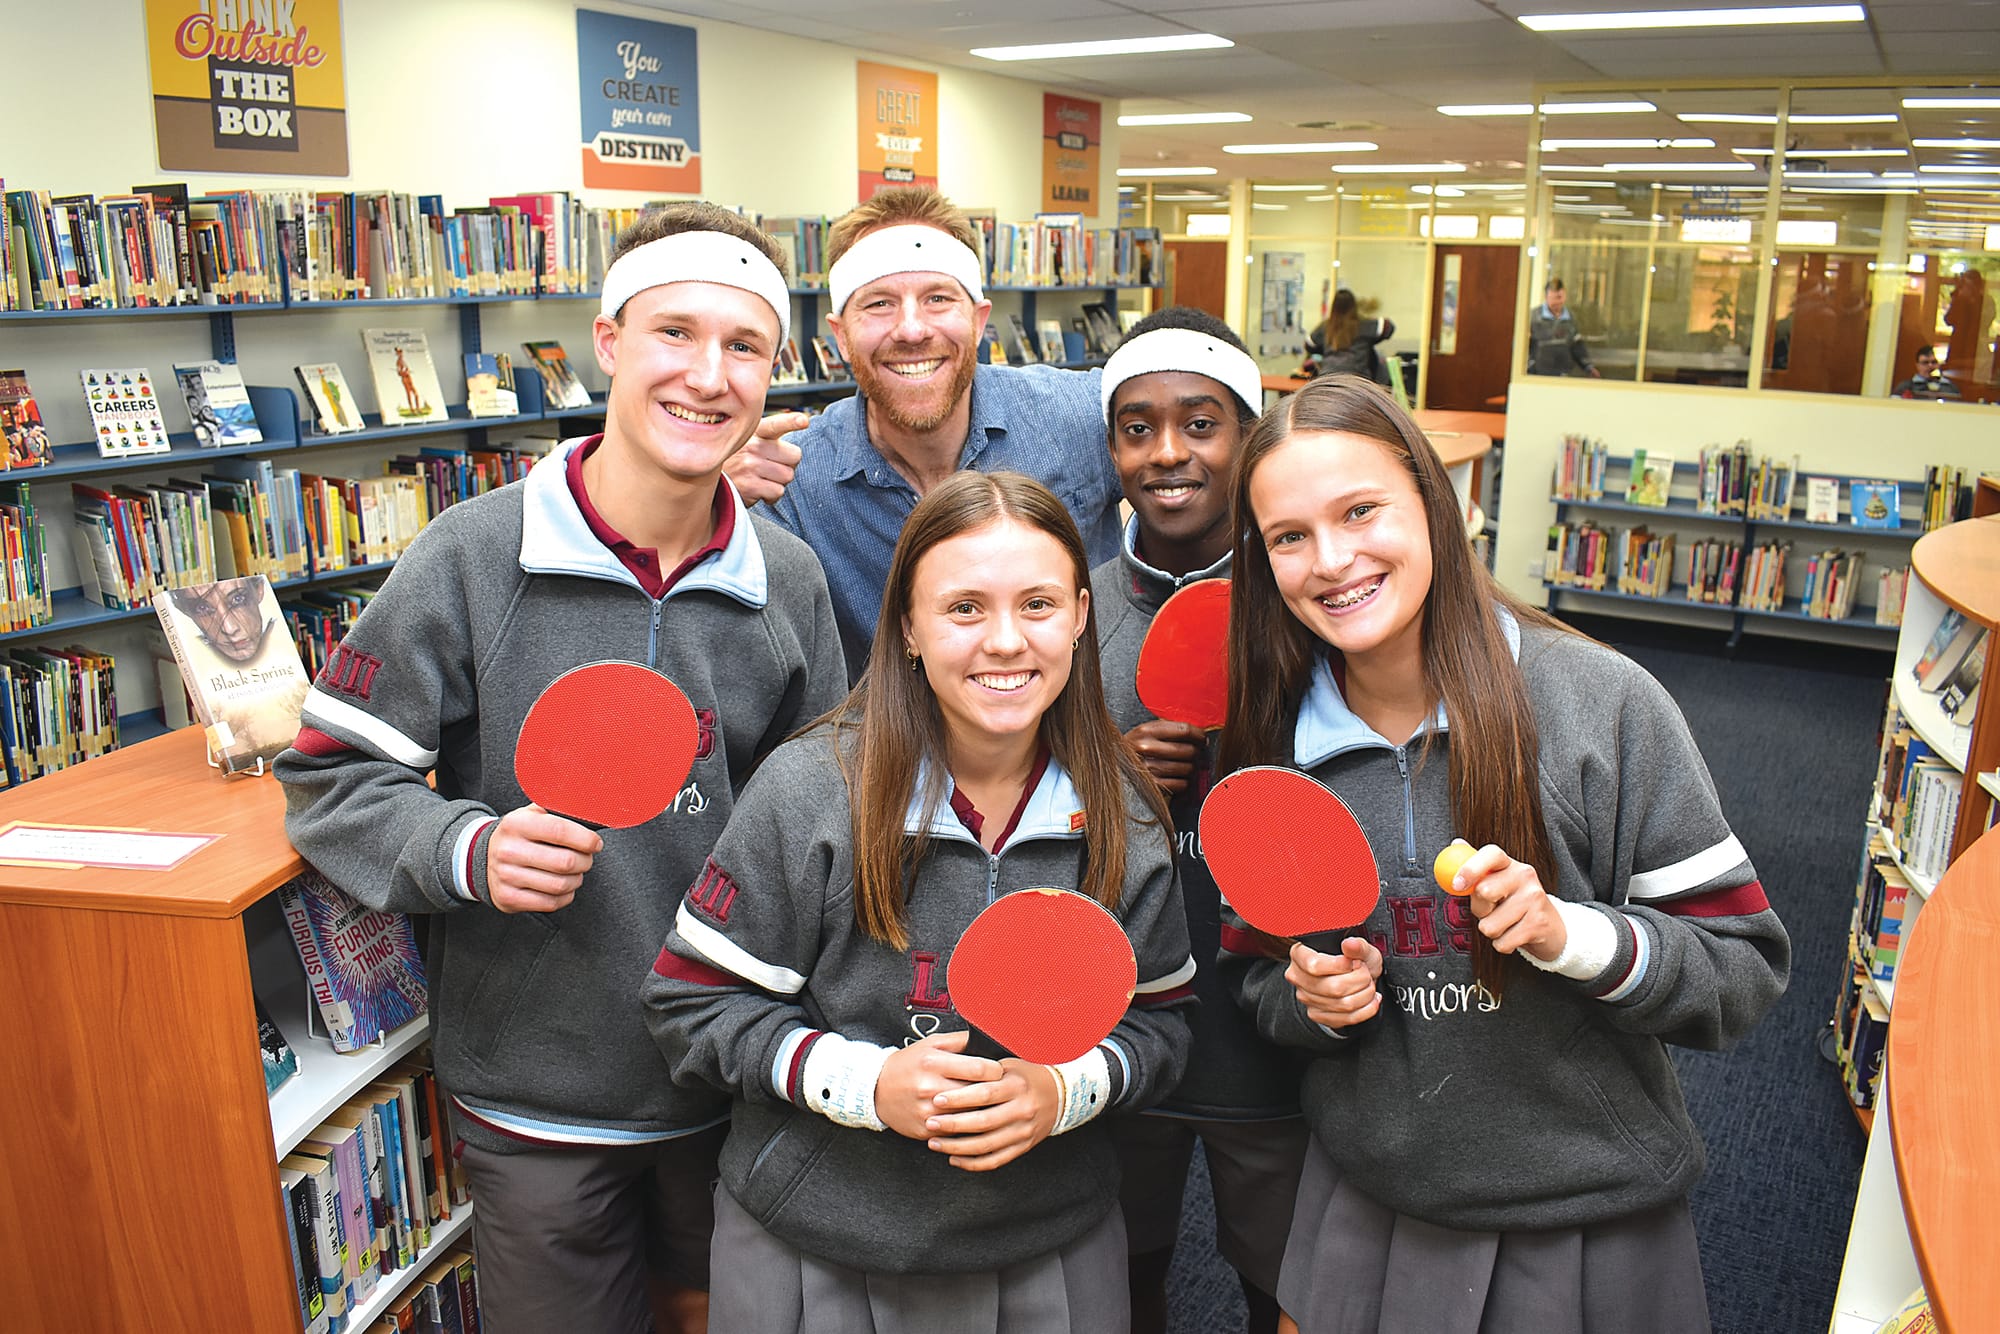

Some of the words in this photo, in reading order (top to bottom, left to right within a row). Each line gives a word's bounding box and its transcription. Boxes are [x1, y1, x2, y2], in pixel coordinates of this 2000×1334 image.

[199, 0, 297, 38] HINK
[175, 14, 326, 67] Outside
[617, 40, 661, 80] You
[214, 69, 291, 103] THE
[602, 79, 681, 107] CREATE
[217, 105, 293, 138] BOX
[611, 107, 644, 128] your
[646, 111, 672, 127] own
[877, 88, 920, 128] GREAT
[600, 137, 685, 162] DESTINY
[93, 399, 156, 414] CAREERS
[95, 410, 158, 422] HANDBOOK
[160, 607, 175, 634] Black
[210, 669, 250, 692] Black
[250, 665, 295, 683] Spring
[333, 911, 395, 960] FURIOUS
[287, 909, 323, 976] FURIOUS
[314, 978, 334, 1005] THI
[353, 935, 395, 974] THING
[1388, 970, 1502, 1020] eniors
